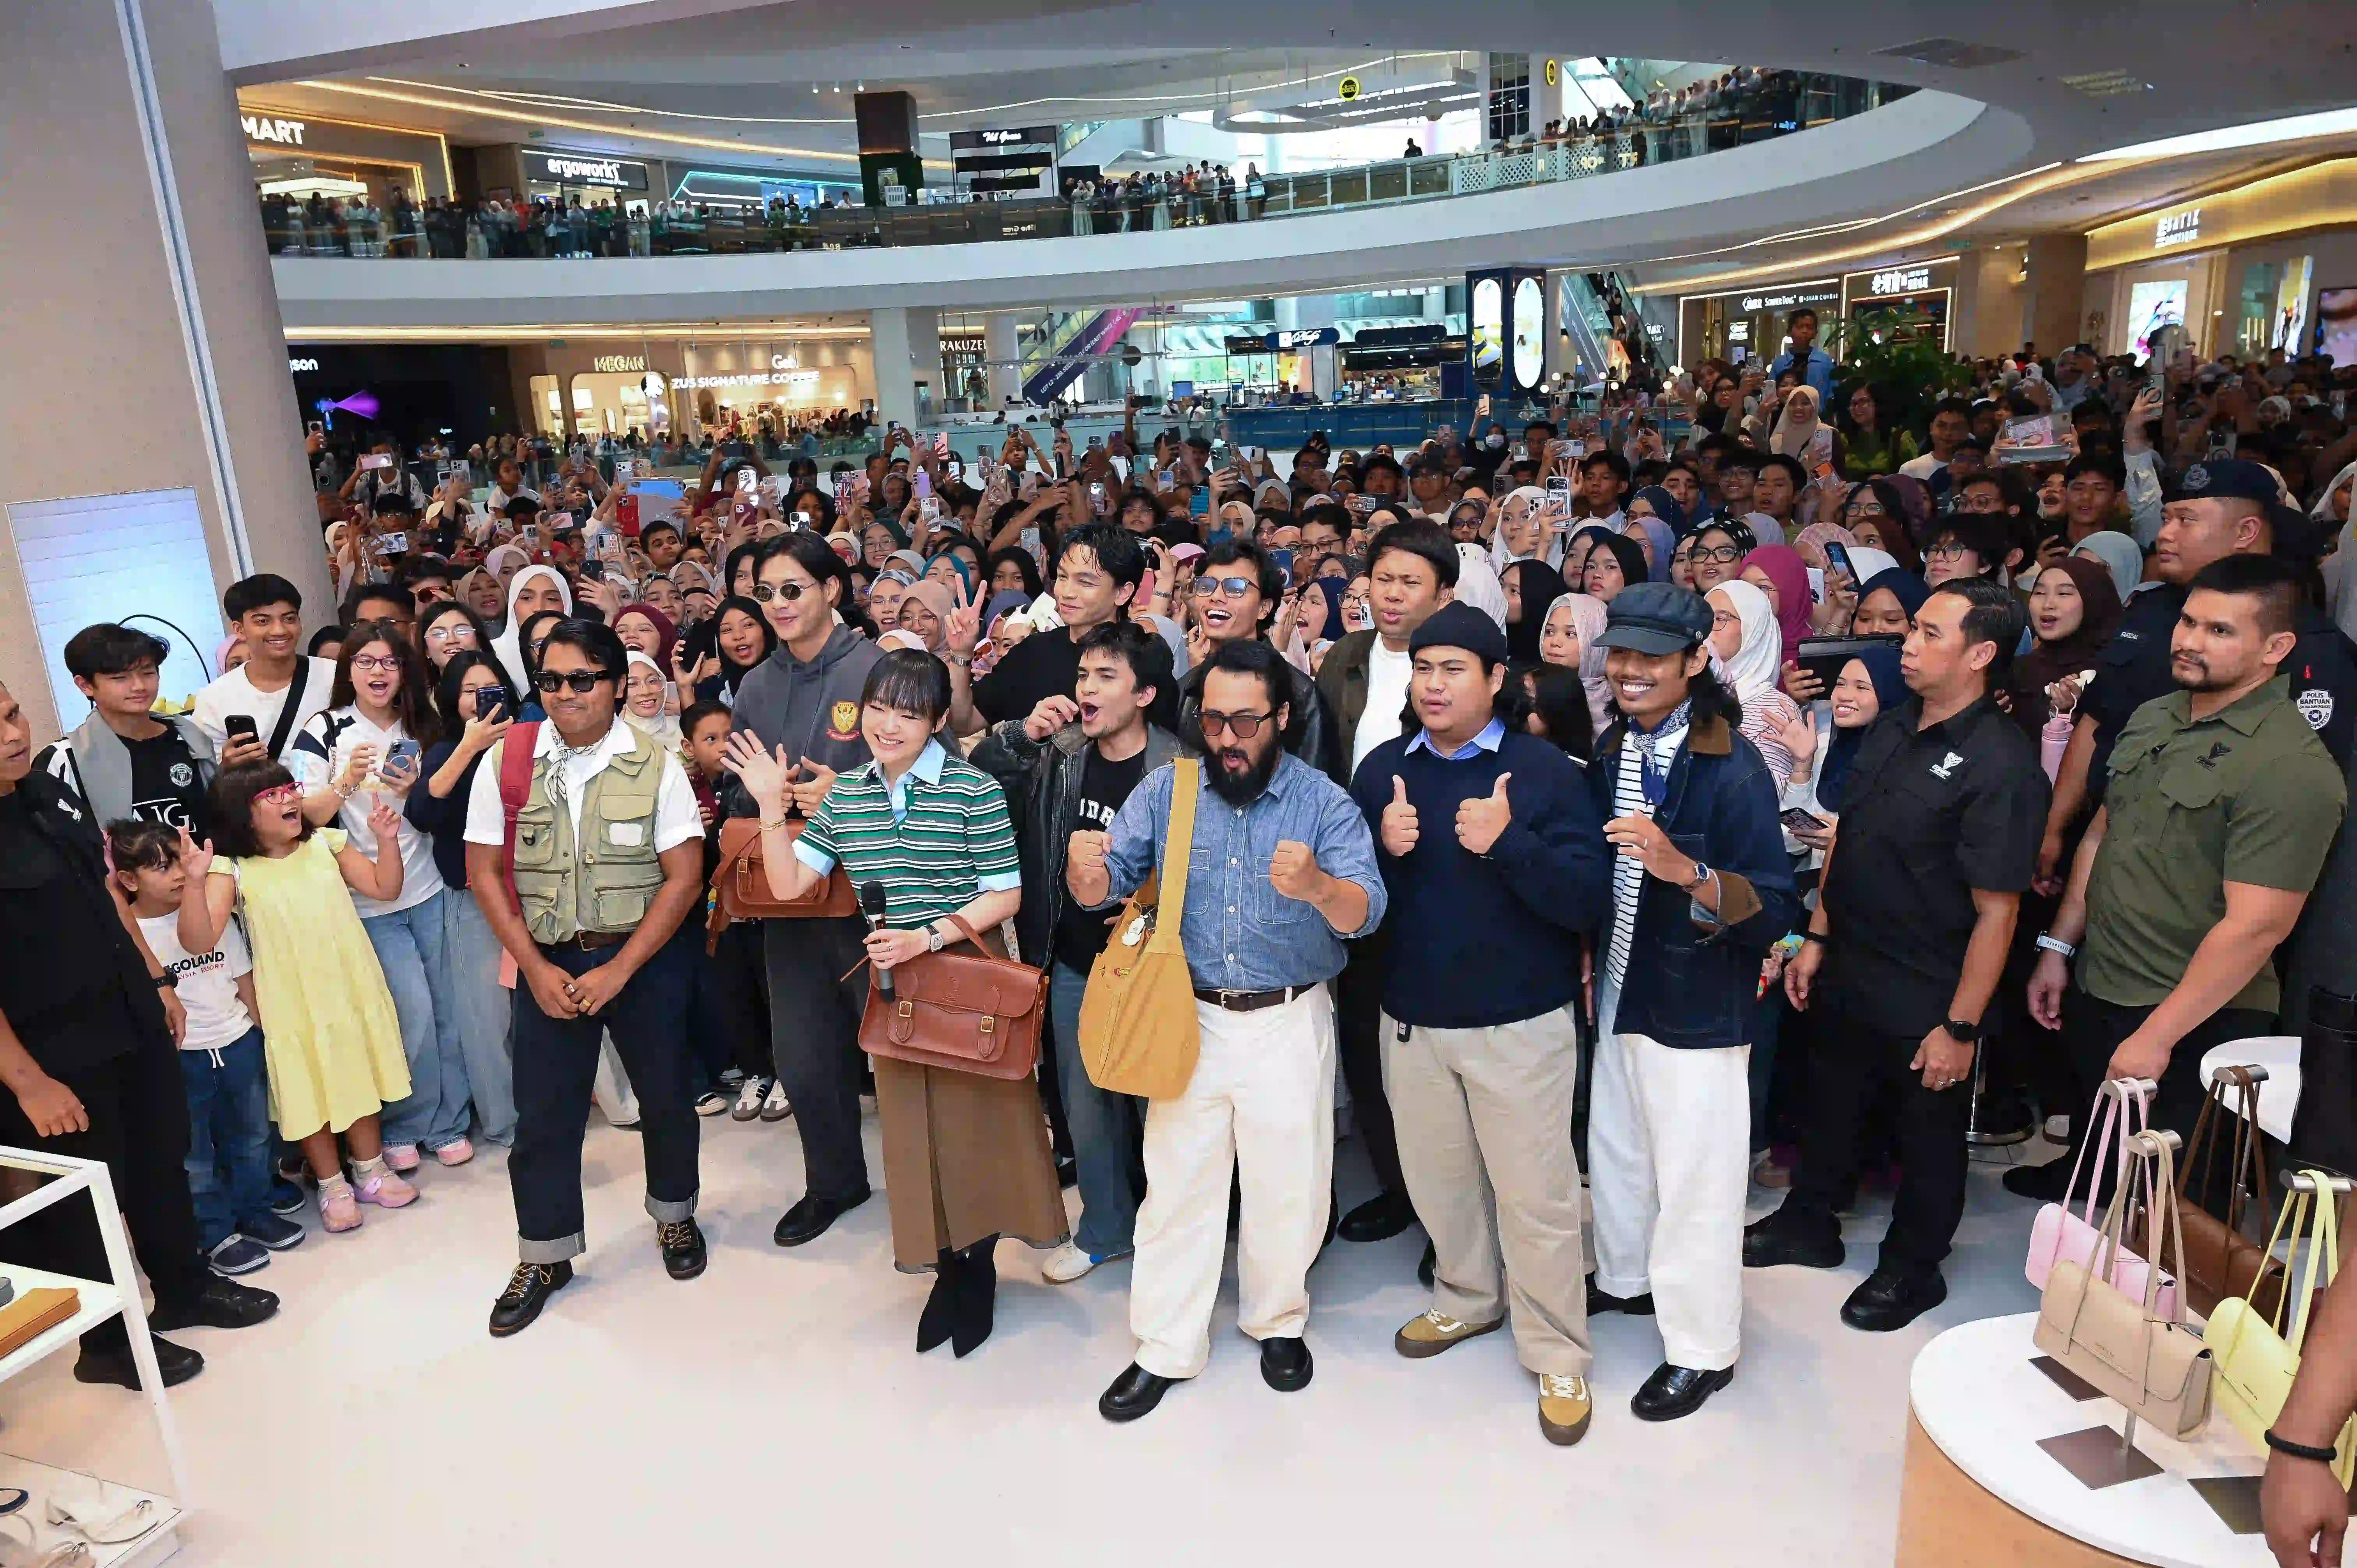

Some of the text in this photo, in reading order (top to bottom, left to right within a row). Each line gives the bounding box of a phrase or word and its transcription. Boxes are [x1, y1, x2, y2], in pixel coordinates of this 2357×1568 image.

[241, 115, 304, 145] MART
[594, 355, 644, 372] MEGAN
[671, 378, 697, 389] ZUS
[698, 373, 770, 388] SIGNATURE
[164, 946, 224, 974] GOLAND
[178, 963, 225, 981] AYSIA RESORT
